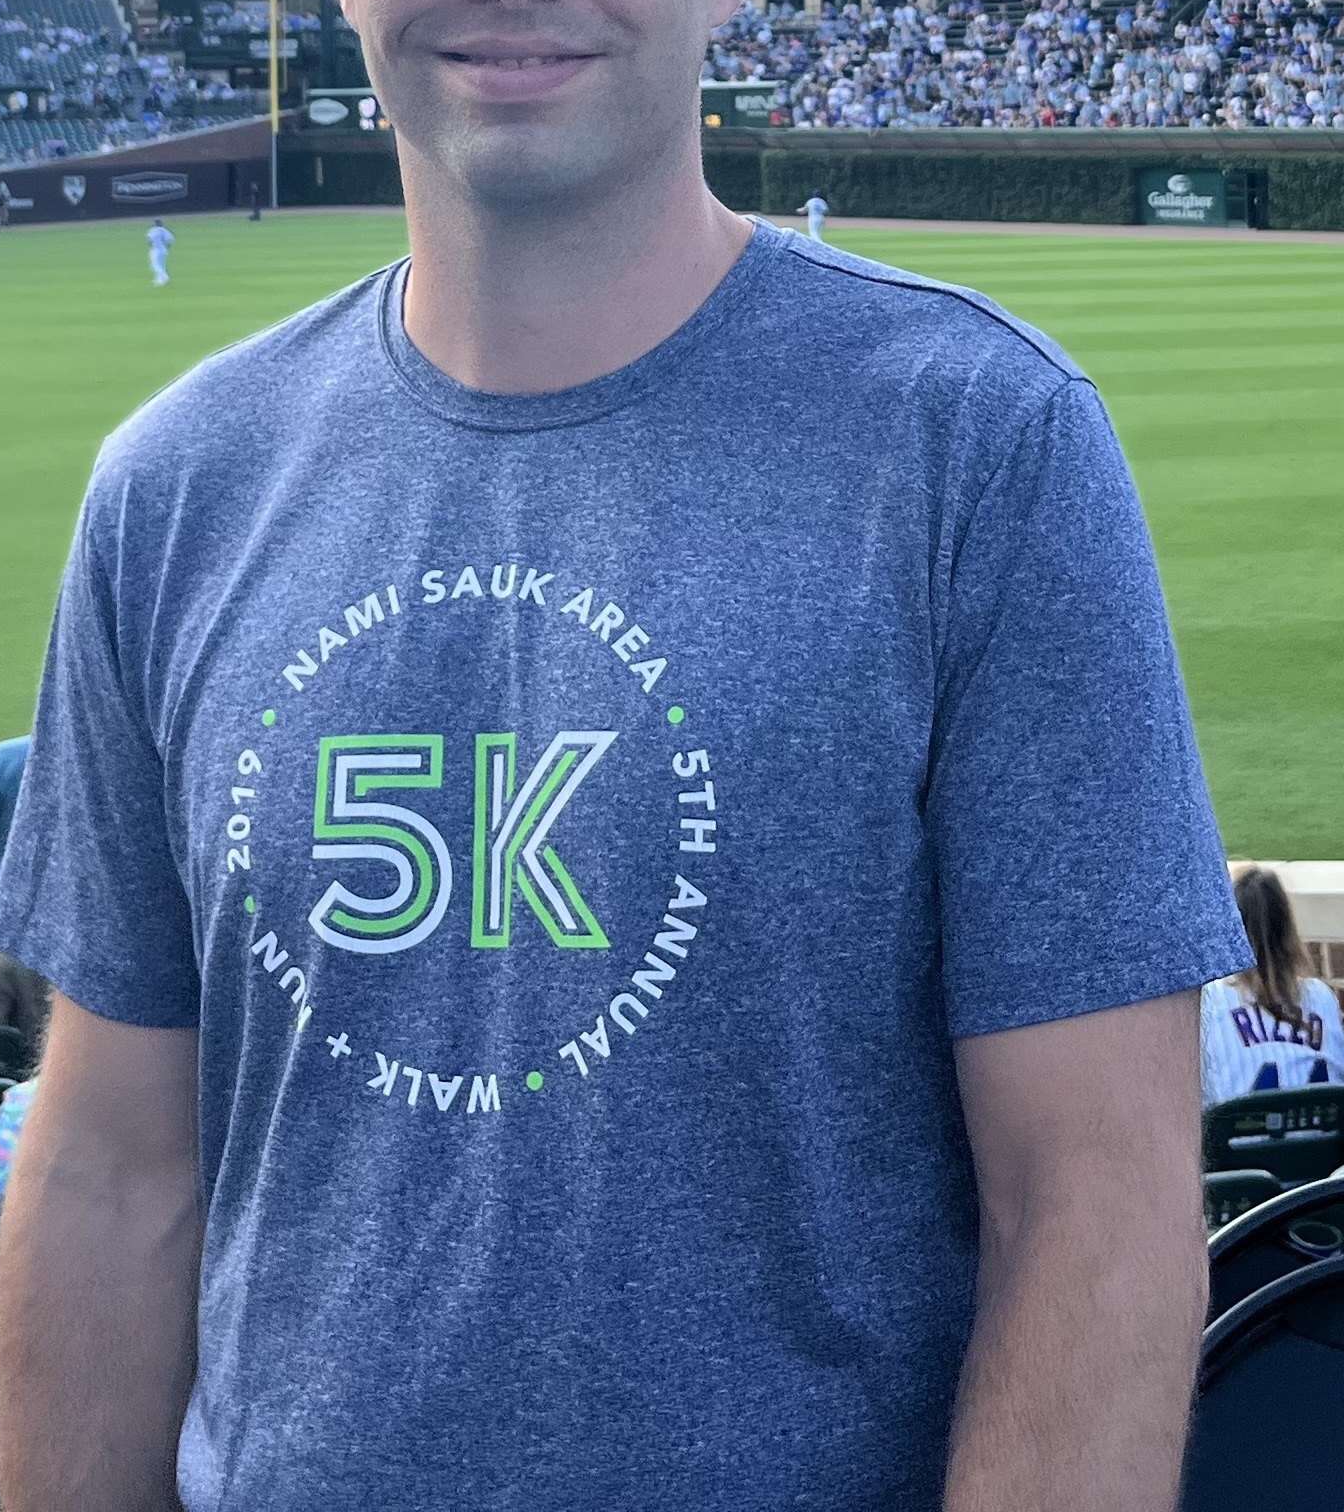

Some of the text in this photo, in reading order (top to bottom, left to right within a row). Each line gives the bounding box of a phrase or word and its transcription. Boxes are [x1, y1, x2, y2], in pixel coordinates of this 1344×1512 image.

[1147, 191, 1214, 210] Gallagher
[282, 564, 668, 693] NAMI SAUK AREA
[227, 748, 262, 873] 2019
[308, 731, 619, 955] 5K
[558, 749, 717, 1077] 5TH ANNUAL
[367, 1051, 502, 1114] WALK
